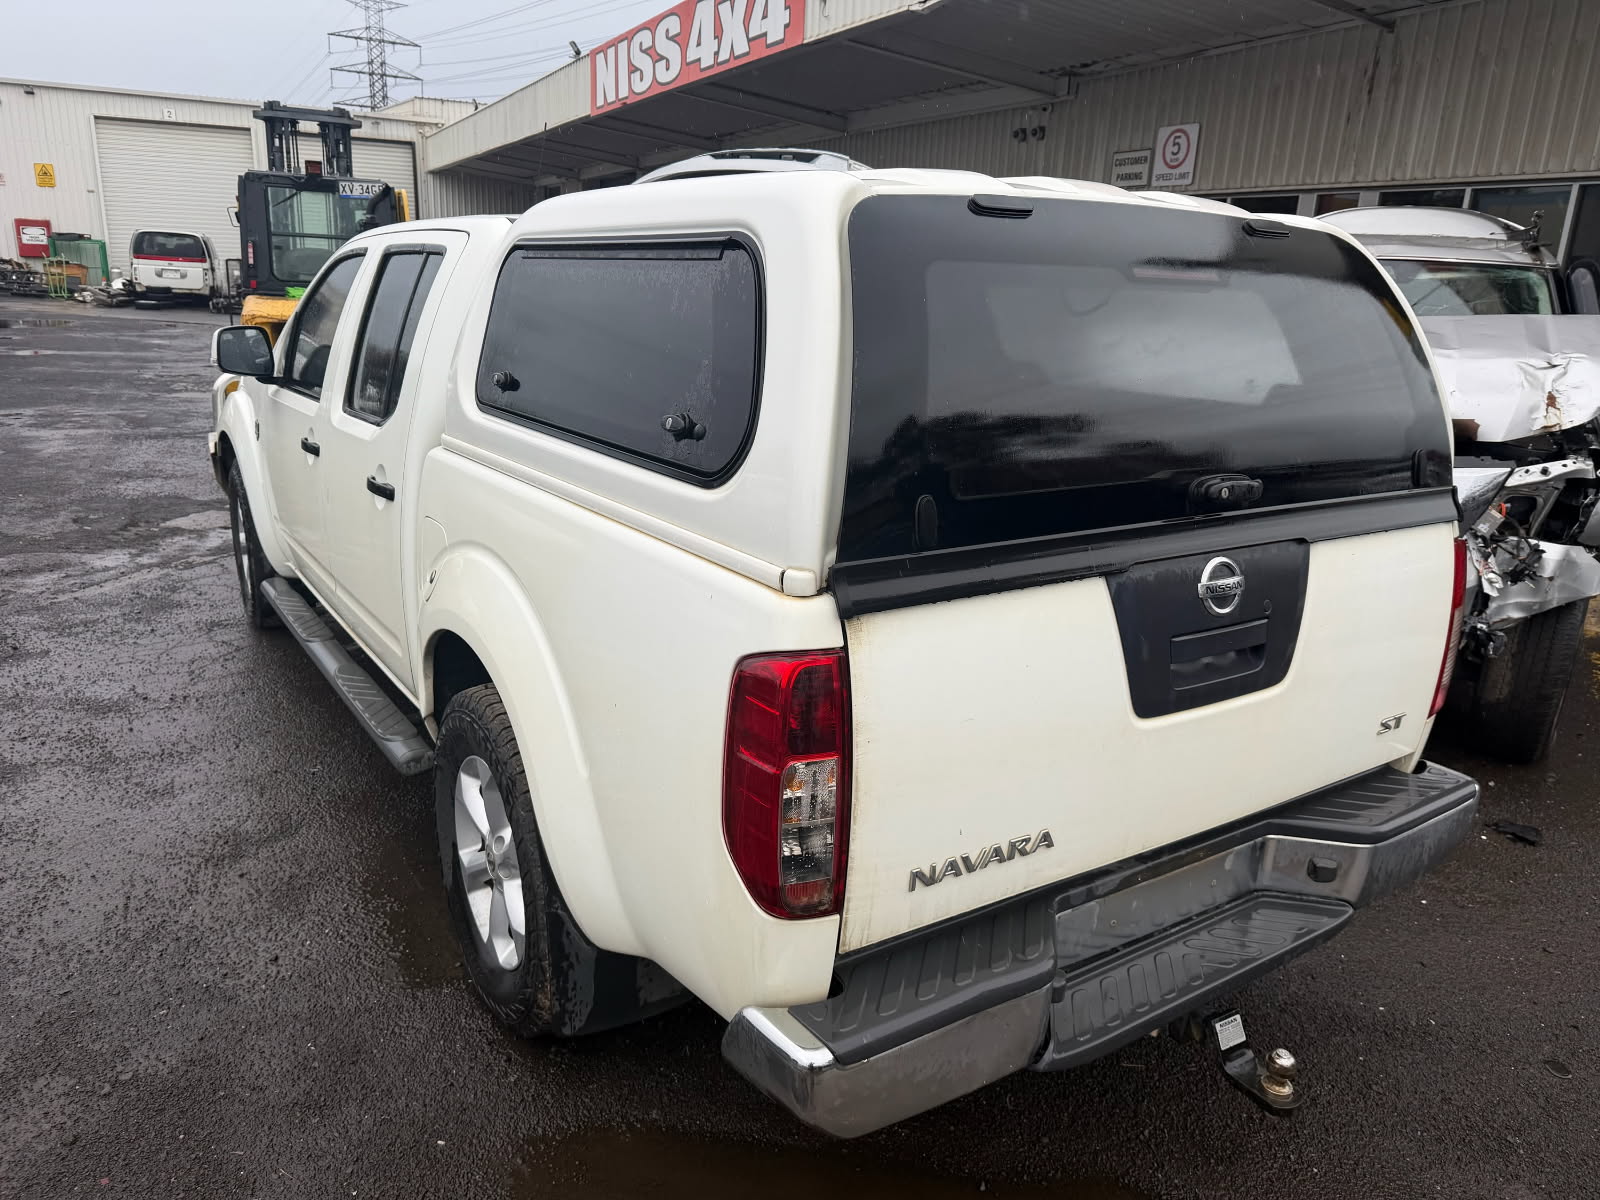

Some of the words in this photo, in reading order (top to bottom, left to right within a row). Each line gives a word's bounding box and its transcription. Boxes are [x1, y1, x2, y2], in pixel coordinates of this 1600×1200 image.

[1171, 135, 1182, 156] 5
[1114, 156, 1148, 167] CUSTOMER
[1116, 172, 1143, 181] PARKING
[1155, 173, 1174, 182] SPEED
[1174, 172, 1191, 181] LIMIT
[1205, 580, 1243, 595] NISSAN
[1376, 712, 1407, 736] ST
[908, 828, 1055, 893] NAVARA
